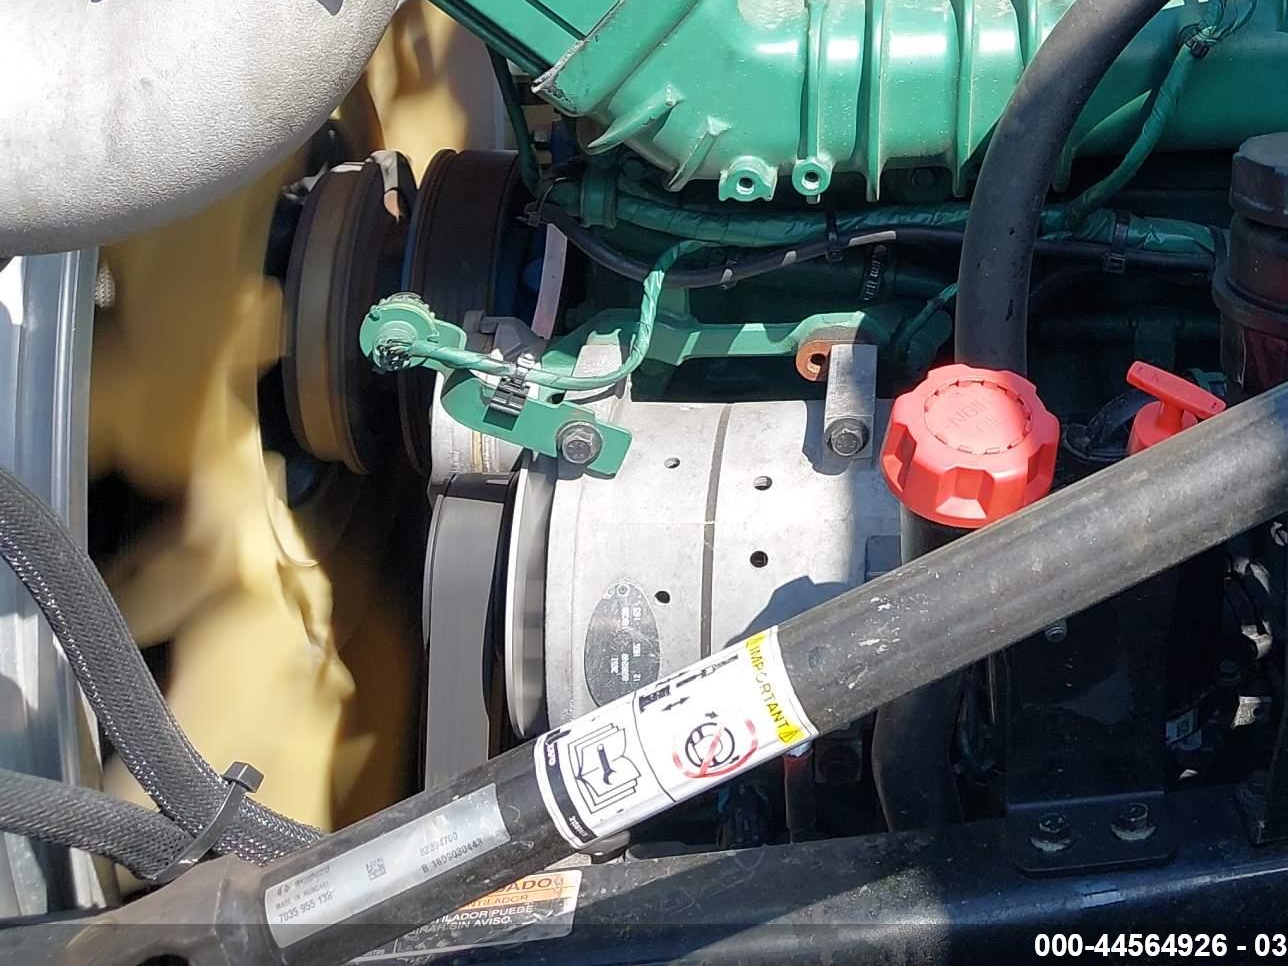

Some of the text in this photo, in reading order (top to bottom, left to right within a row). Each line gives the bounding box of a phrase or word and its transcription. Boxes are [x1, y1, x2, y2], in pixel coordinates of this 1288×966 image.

[748, 645, 790, 729] IMPORTANT
[300, 900, 316, 914] 955
[490, 905, 535, 918] PUEDE
[473, 915, 513, 927] AVISO.
